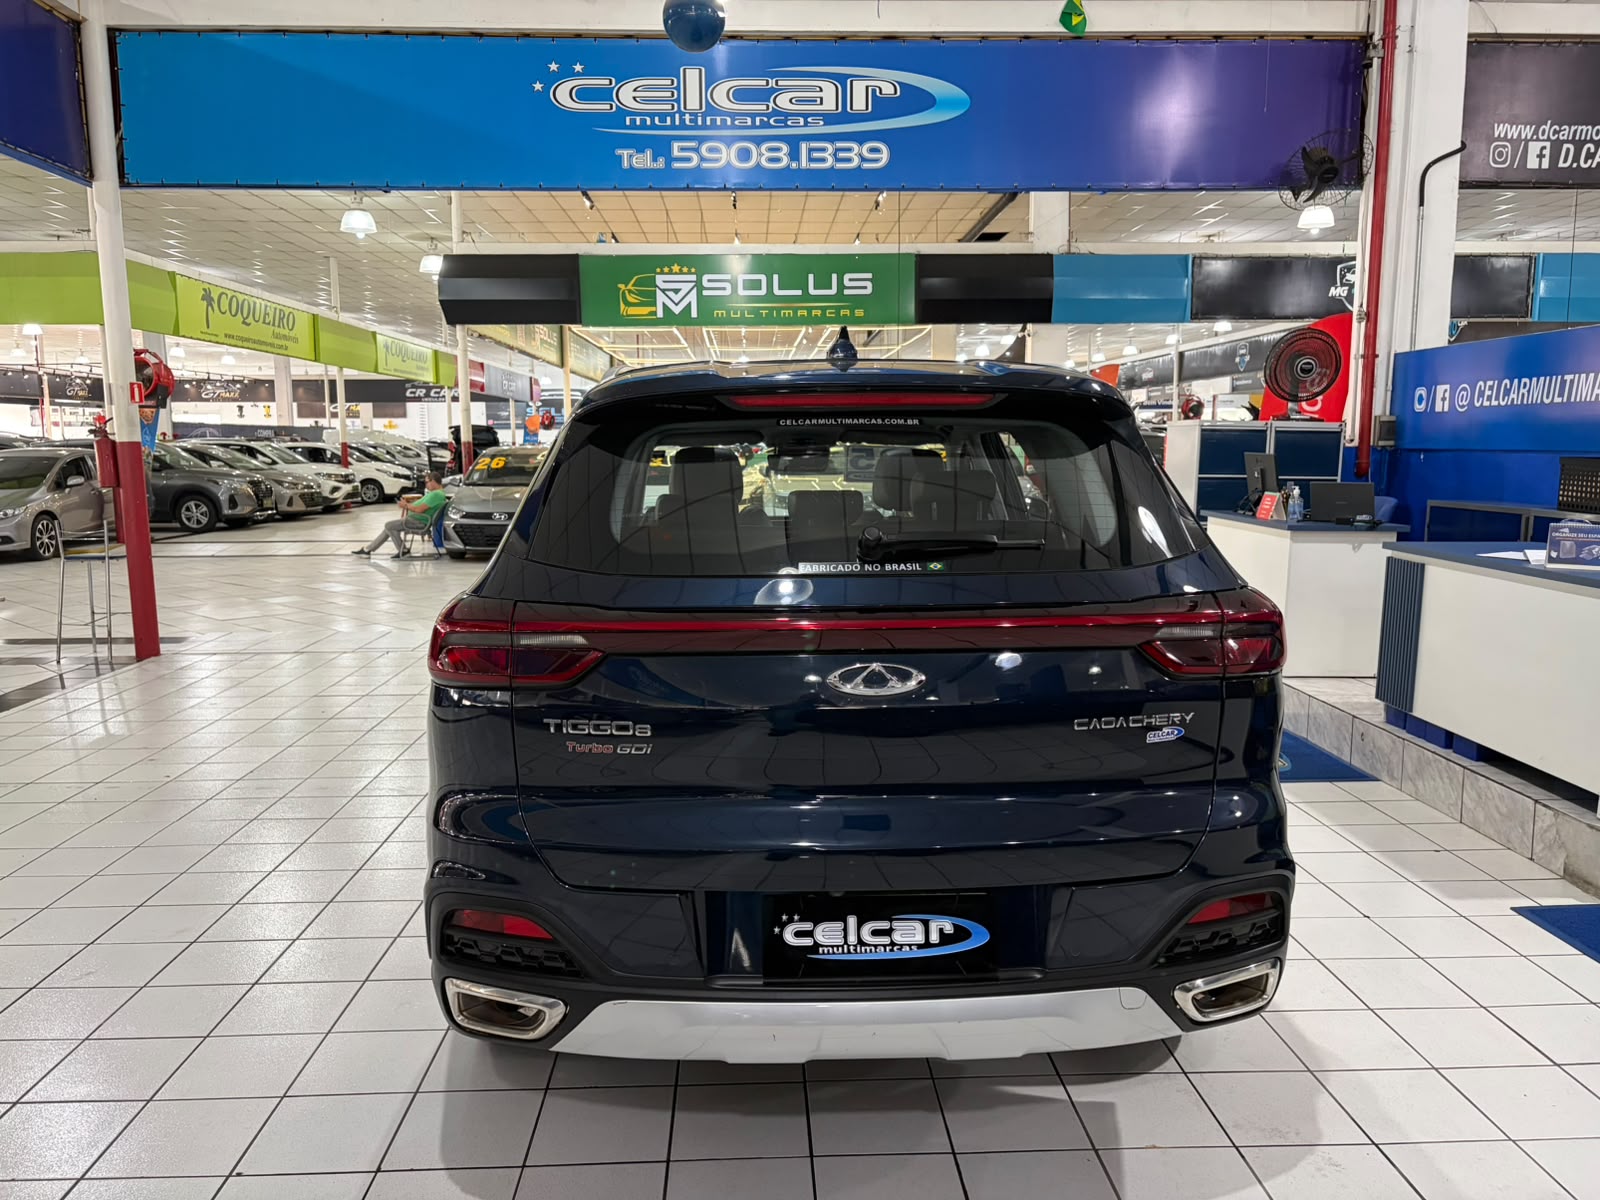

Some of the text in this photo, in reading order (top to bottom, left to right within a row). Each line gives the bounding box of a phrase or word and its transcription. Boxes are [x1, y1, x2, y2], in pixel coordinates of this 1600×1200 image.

[550, 67, 901, 114] celcar
[625, 114, 825, 127] multimarcas
[671, 141, 890, 170] 5908.1339
[701, 273, 874, 297] SOLUS
[1328, 286, 1349, 298] MG
[216, 291, 297, 332] COQUEIRO
[713, 309, 865, 318] MULTIMARCAS
[405, 388, 426, 397] CR
[780, 418, 920, 426] CELCARMULTIMARCAS.COM.BR
[474, 457, 507, 470] 26
[799, 562, 922, 573] FABRICADO NO BRASIL
[1147, 730, 1177, 740] CELCAR
[566, 741, 614, 753] Turbo
[783, 915, 954, 946] celcar
[819, 944, 918, 954] multimarcas
